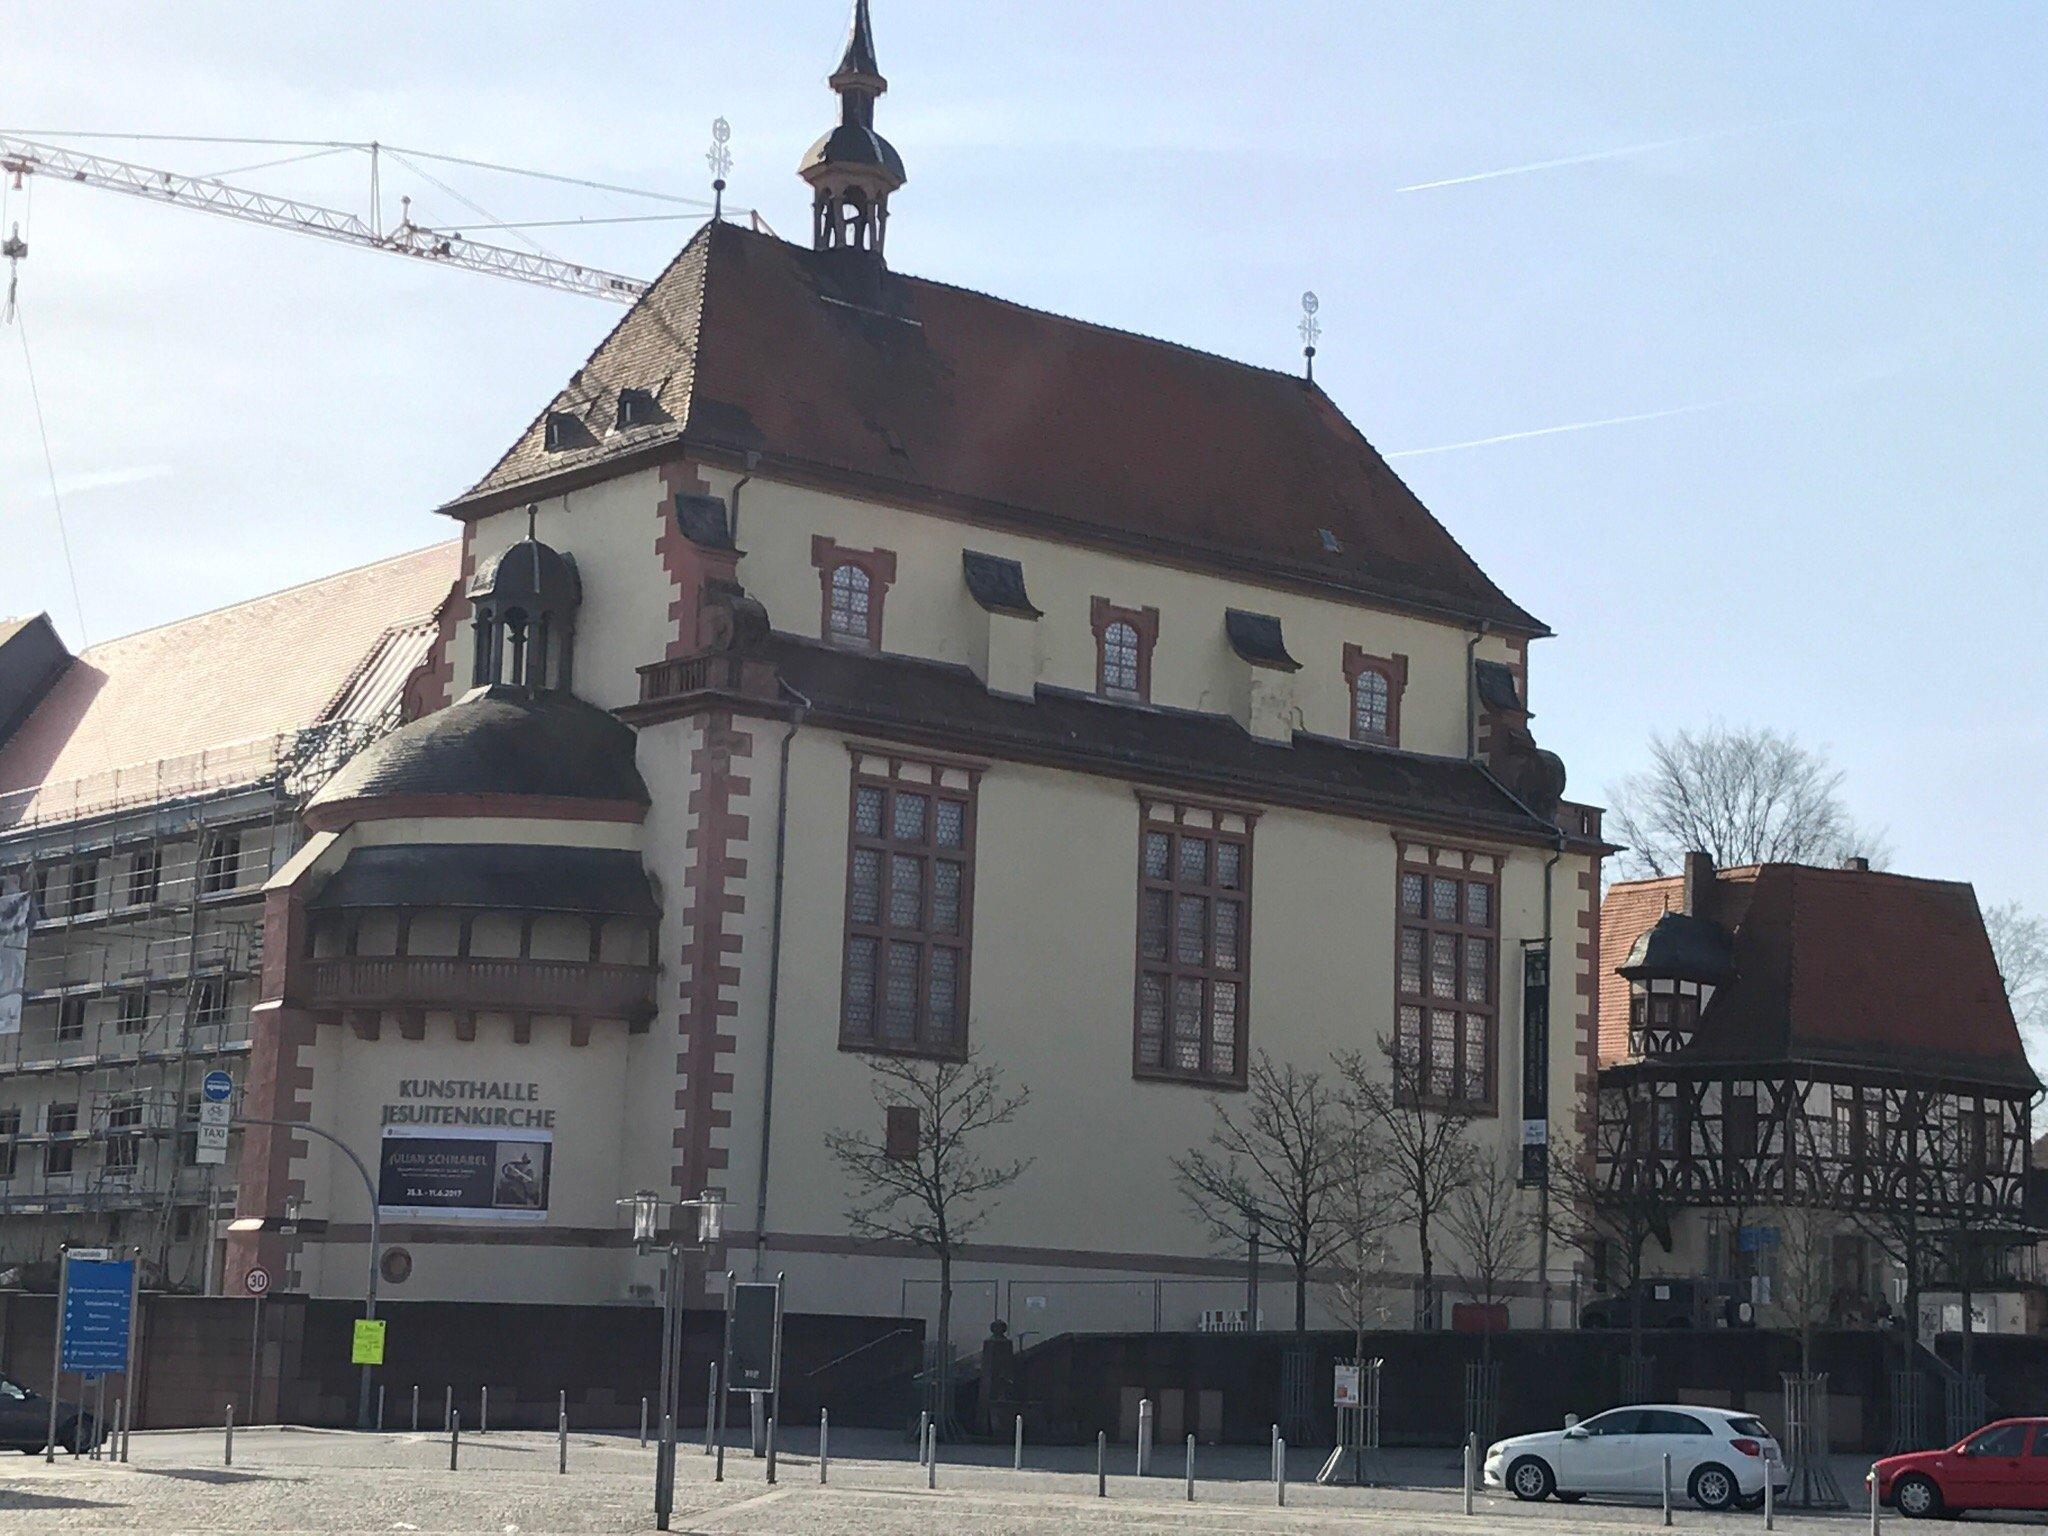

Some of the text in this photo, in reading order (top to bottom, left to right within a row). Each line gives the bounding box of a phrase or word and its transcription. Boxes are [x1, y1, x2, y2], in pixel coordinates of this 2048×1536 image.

[399, 1079, 539, 1102] KUNSTHALLE
[381, 1104, 556, 1128] JESUITENKIRCHE
[203, 1127, 225, 1138] TAXI
[389, 1153, 488, 1166] JULIAN SCHNABEL
[249, 1274, 265, 1288] 30
